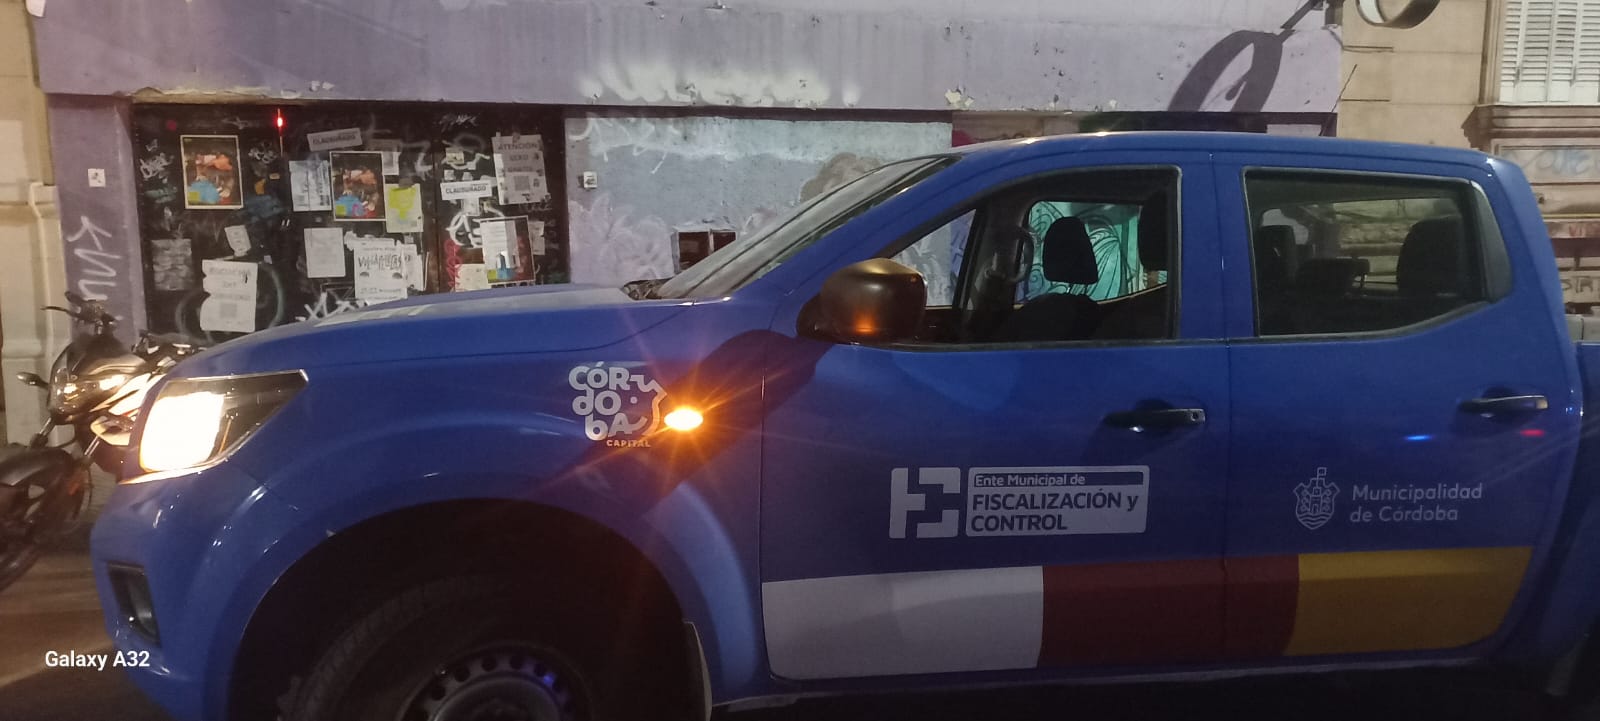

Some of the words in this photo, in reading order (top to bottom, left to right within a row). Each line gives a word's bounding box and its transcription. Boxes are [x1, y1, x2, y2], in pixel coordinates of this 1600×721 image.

[606, 439, 651, 448] CAPITAL
[975, 475, 1004, 487] Ente
[1007, 474, 1067, 487] Municipal
[1069, 474, 1086, 485] de
[972, 488, 1122, 511] FISCALIZACIÓN
[1127, 495, 1139, 512] y
[1352, 482, 1483, 503] Municipalidad
[1350, 506, 1373, 523] de
[1379, 504, 1459, 522] Córdoba
[971, 514, 1068, 532] CONTROL
